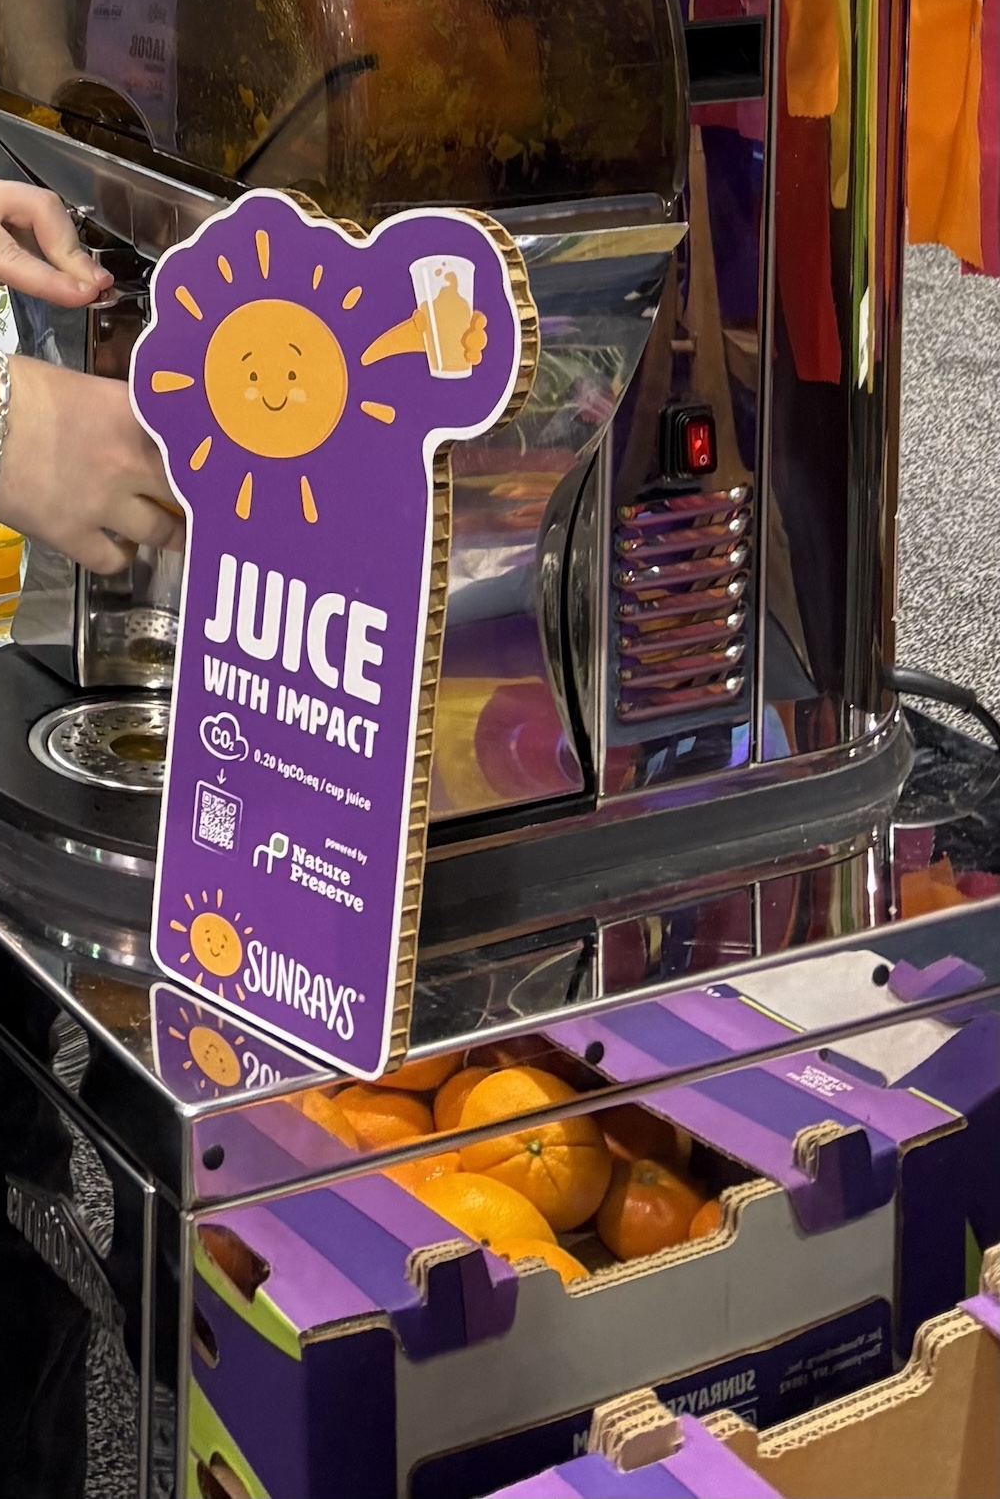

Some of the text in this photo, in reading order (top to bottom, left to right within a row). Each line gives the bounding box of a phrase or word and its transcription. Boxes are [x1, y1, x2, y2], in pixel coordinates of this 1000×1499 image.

[203, 553, 388, 705] JUICE
[203, 654, 379, 759] WITH IMPACT
[253, 748, 276, 770] 0.20
[325, 782, 345, 801] cup
[345, 788, 372, 812] juice
[291, 844, 352, 886] Nature
[325, 837, 368, 866] powered by
[289, 863, 364, 913] Preserve
[243, 940, 358, 1040] SUNRAYS
